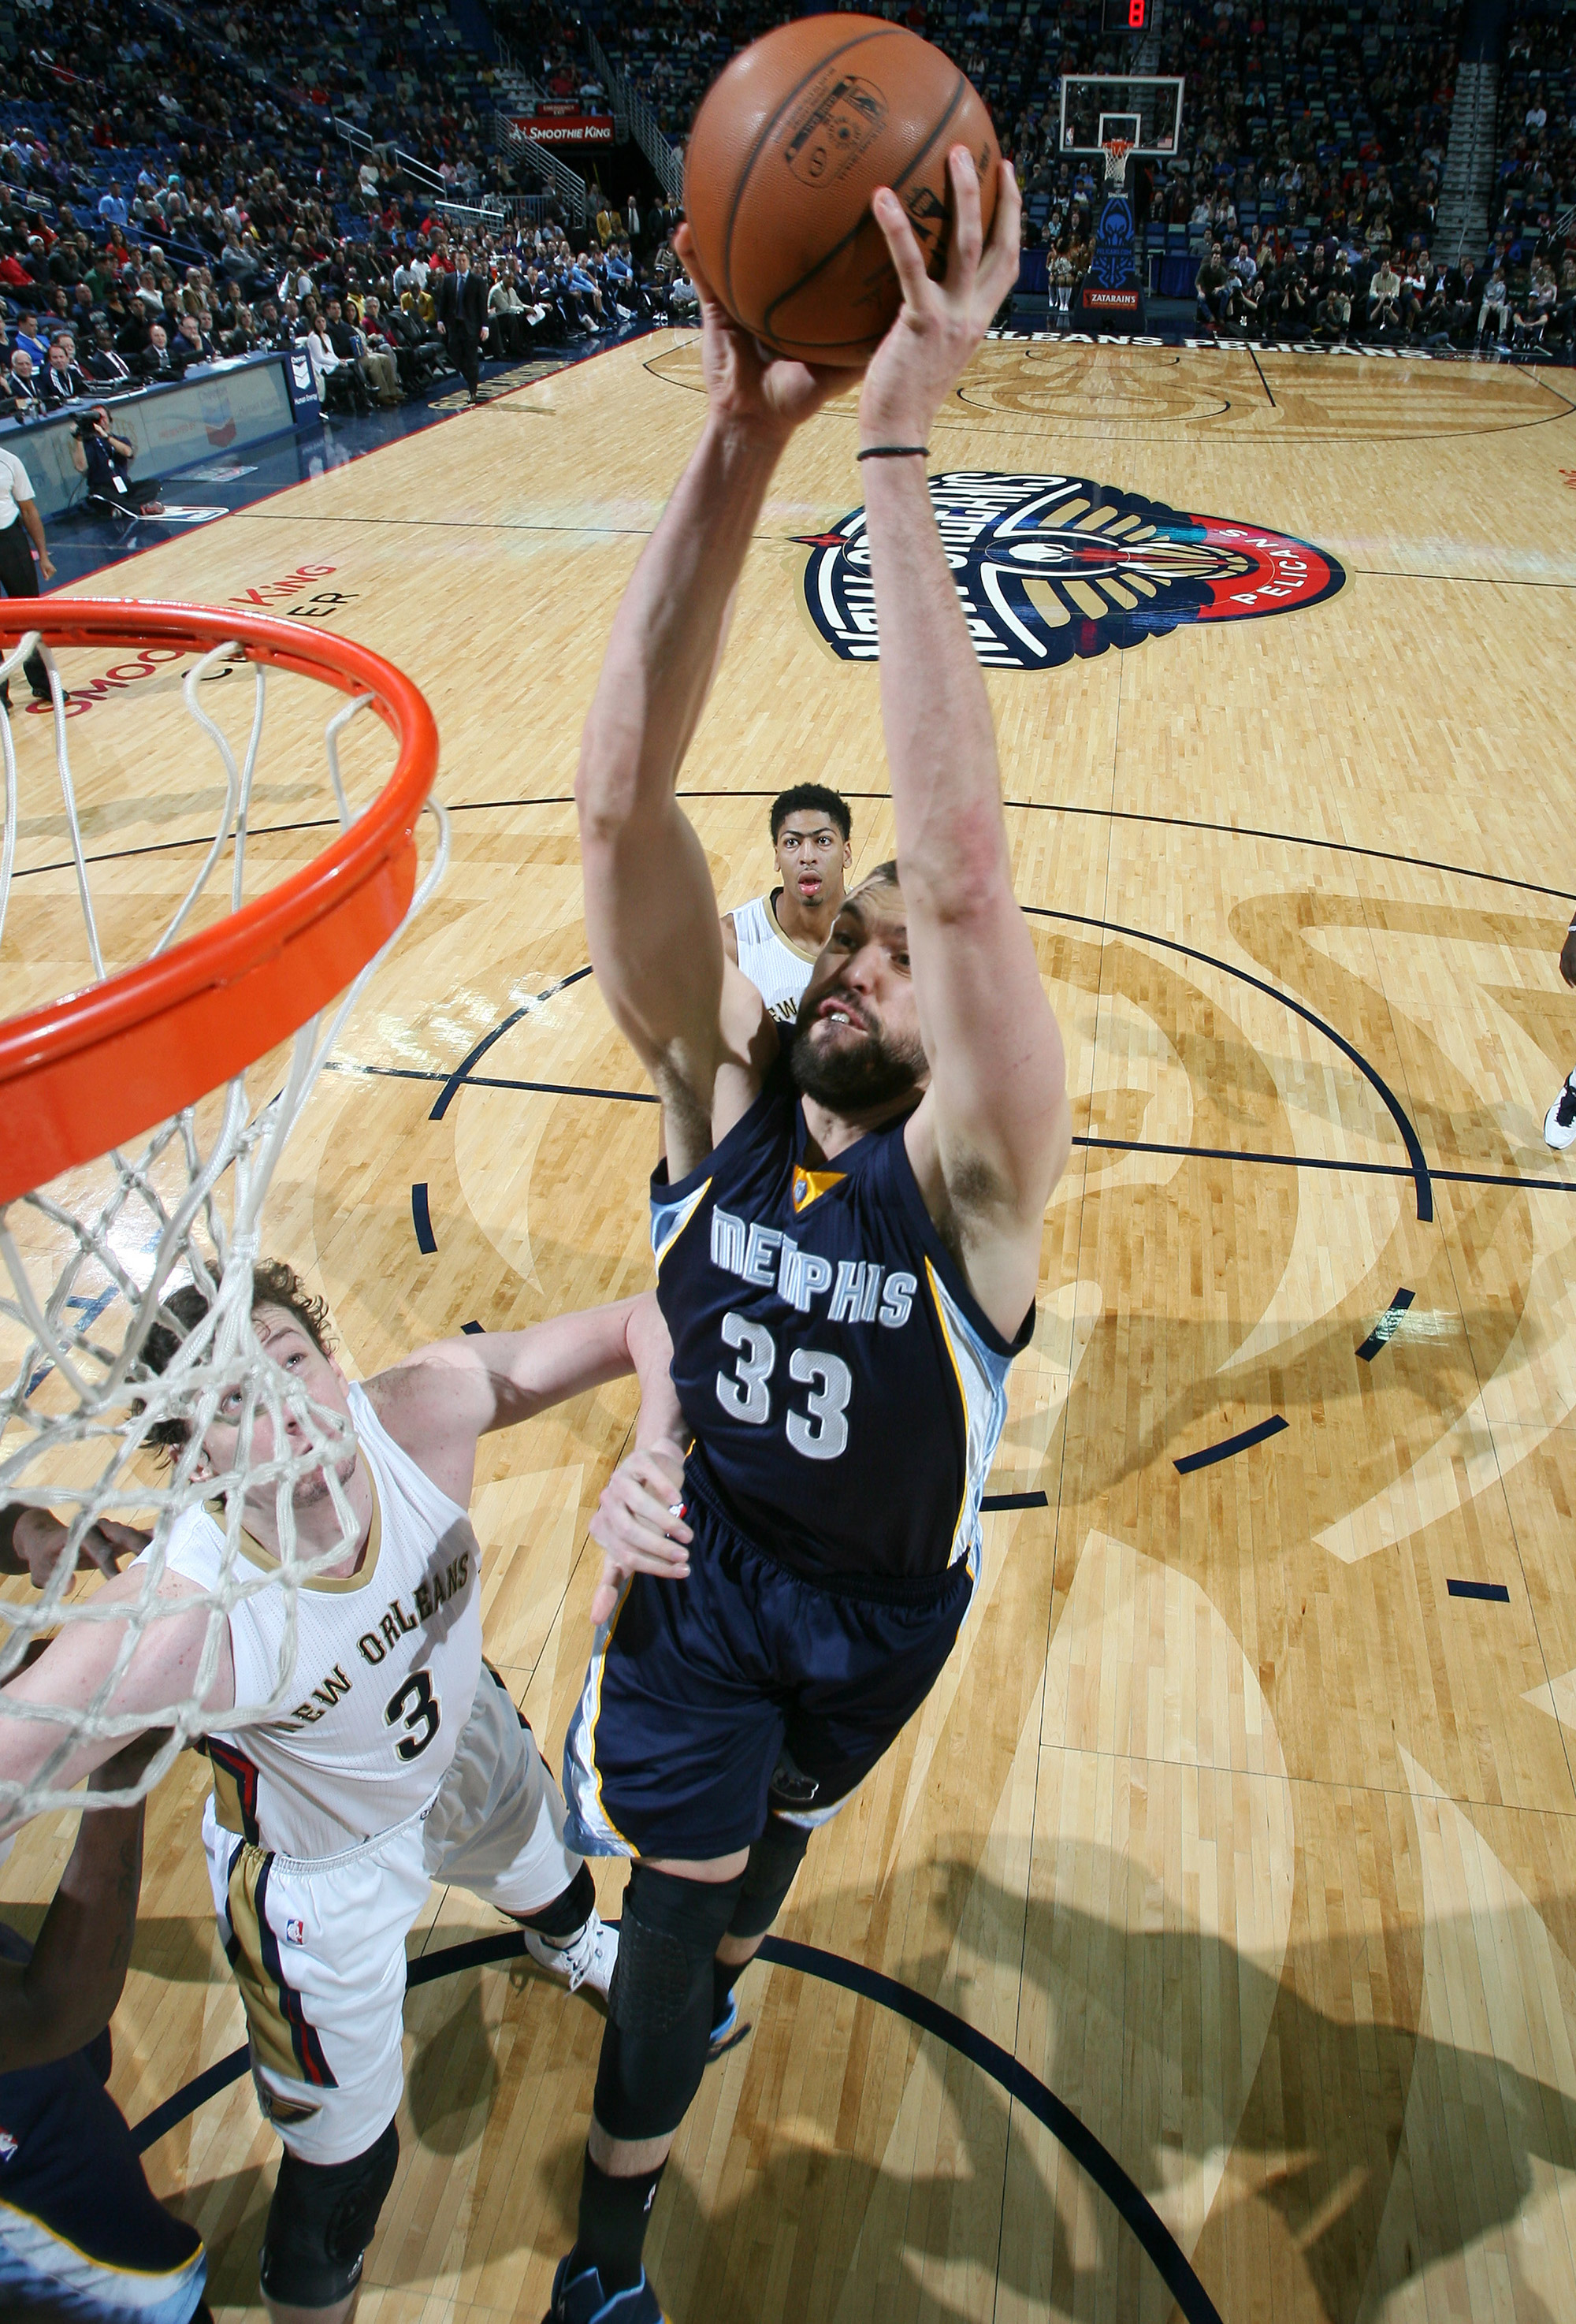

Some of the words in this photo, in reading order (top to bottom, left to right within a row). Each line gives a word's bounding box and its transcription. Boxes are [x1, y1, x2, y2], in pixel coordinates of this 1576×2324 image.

[529, 127, 582, 139] SMOOTHIE
[983, 329, 1162, 347] RLEANS
[1184, 338, 1433, 359] PELICANS
[1218, 527, 1308, 606] PELICANS
[768, 997, 797, 1023] EW
[710, 1203, 918, 1329] MEMPHIS
[716, 1311, 853, 1460] 33
[356, 1549, 470, 1666] ORLEANS
[381, 1666, 442, 1764] 3
